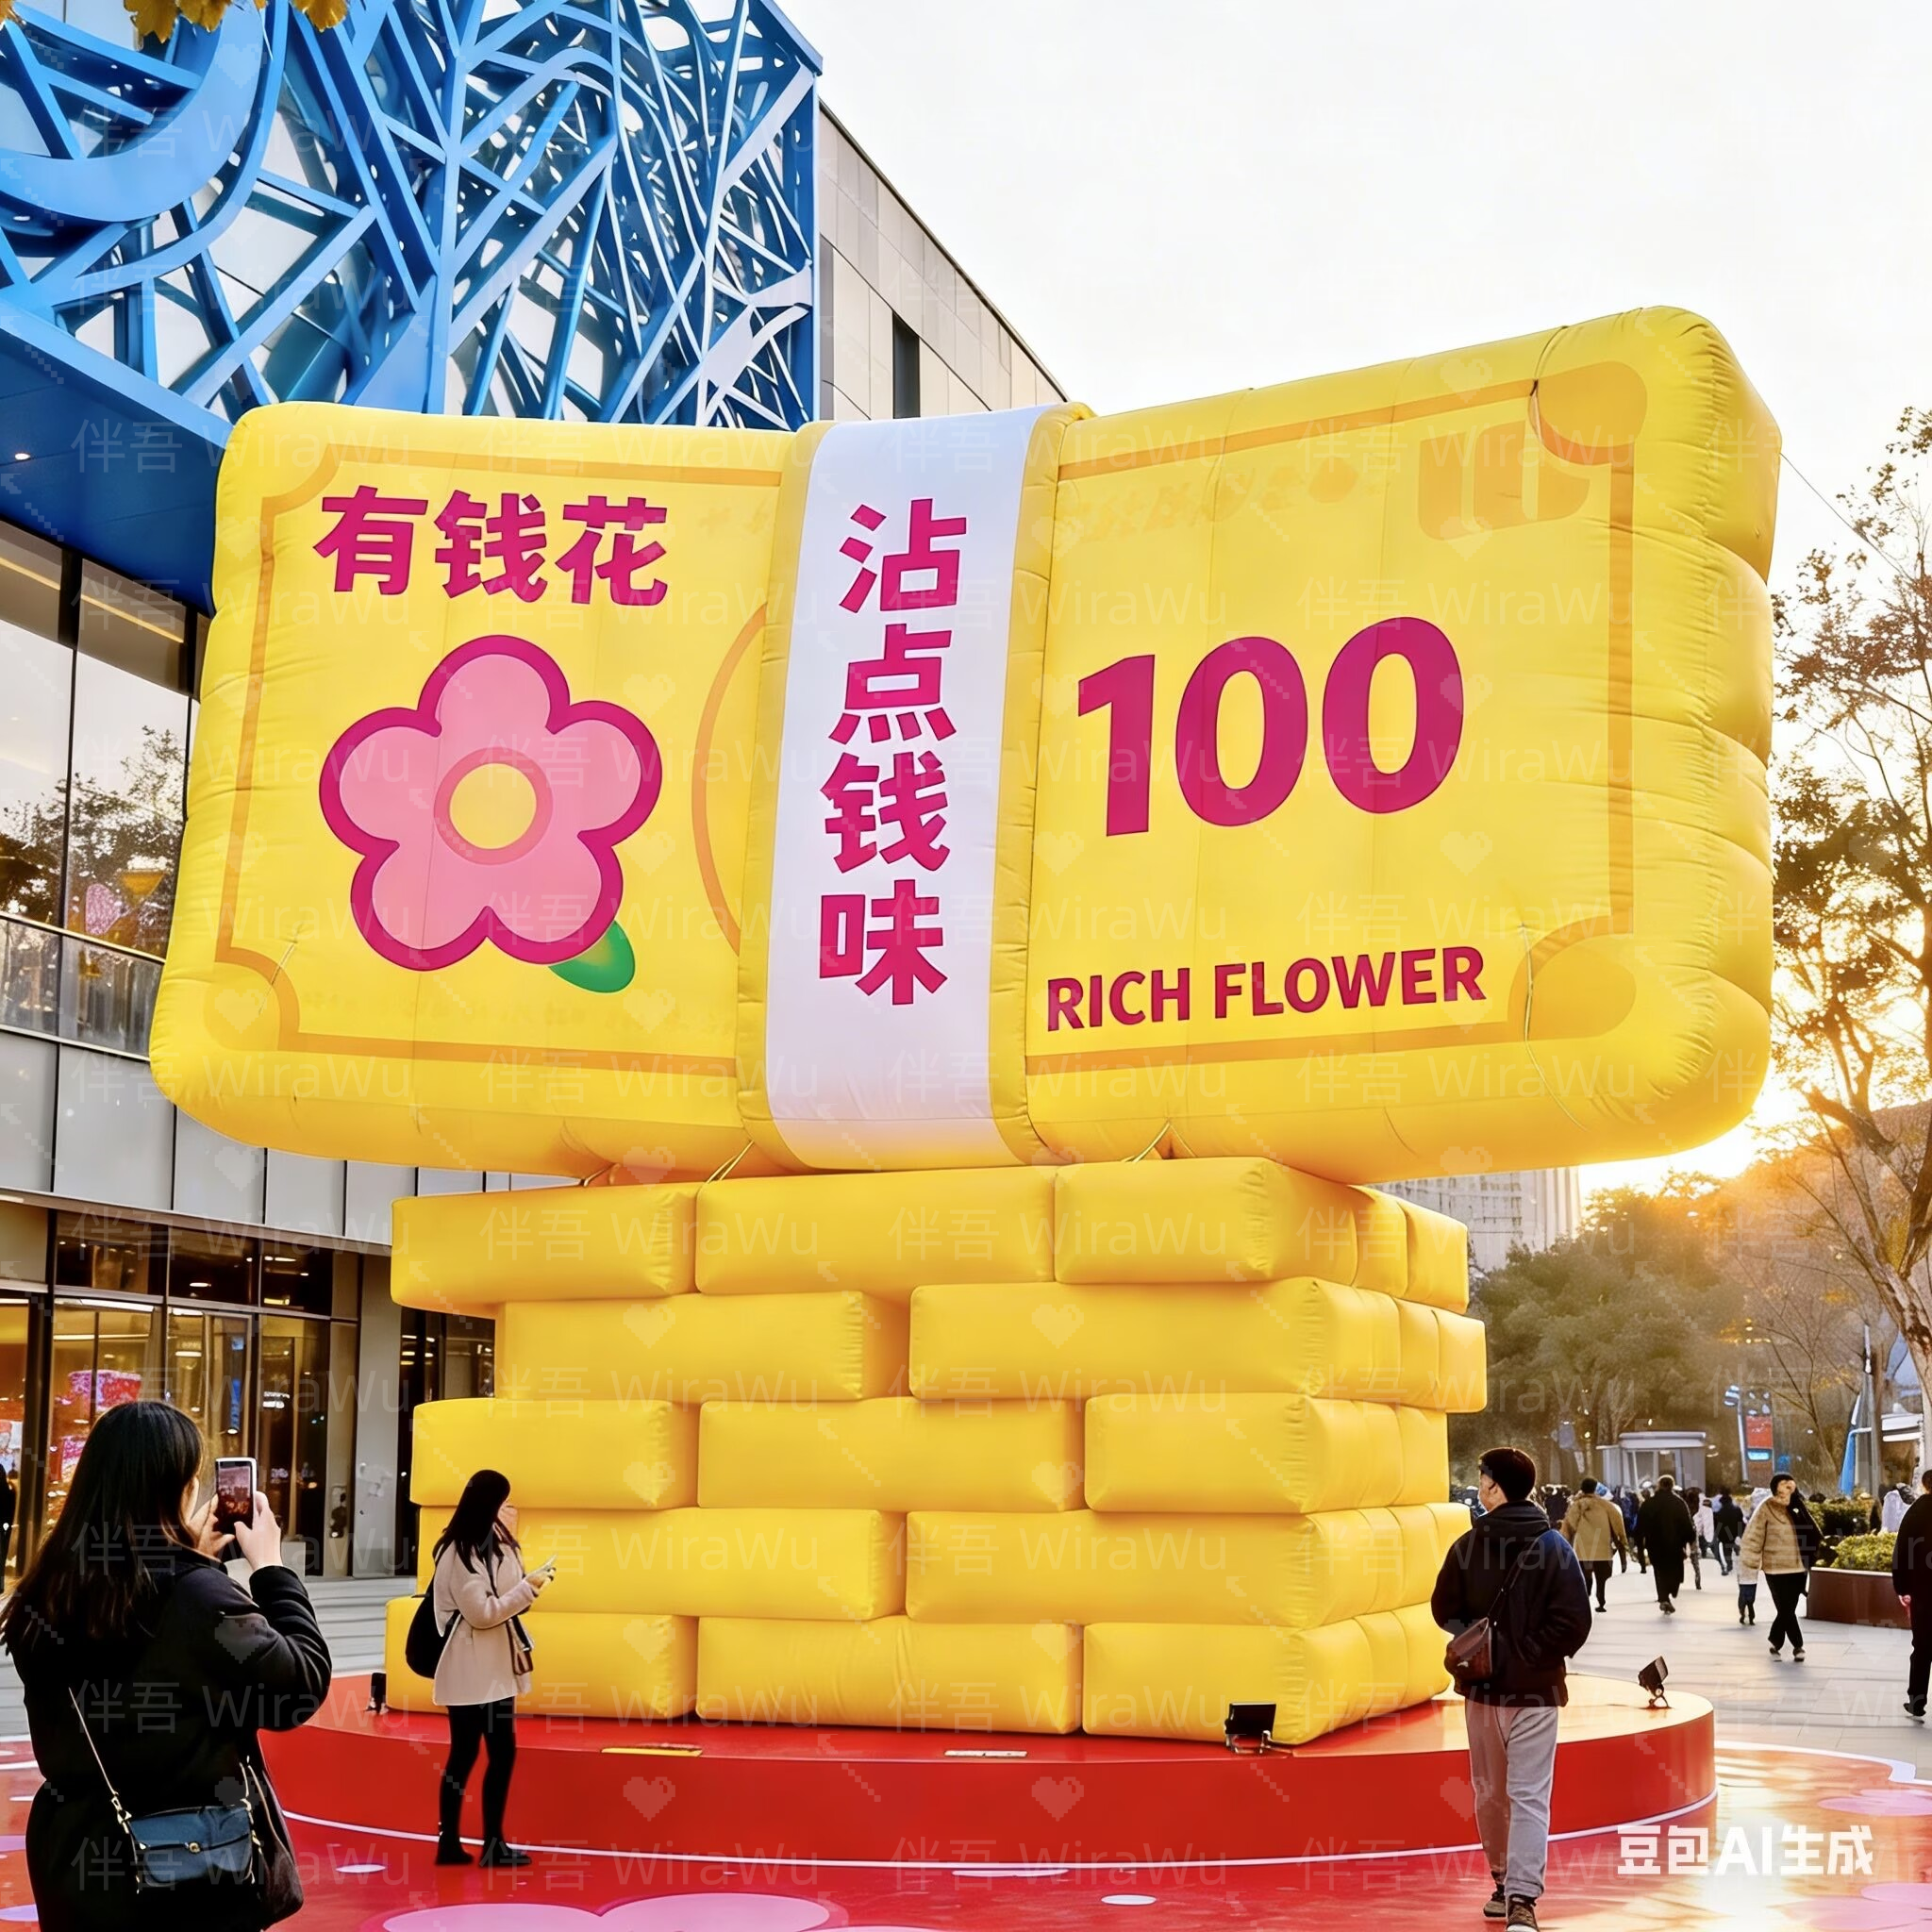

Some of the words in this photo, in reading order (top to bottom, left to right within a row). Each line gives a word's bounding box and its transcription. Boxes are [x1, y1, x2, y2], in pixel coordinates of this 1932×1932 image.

[314, 485, 668, 607] 有钱花
[818, 497, 968, 1007] 沾点钱味
[1077, 616, 1465, 837] 100
[1047, 966, 1191, 1032] RICH
[1214, 946, 1487, 1020] FLOWER
